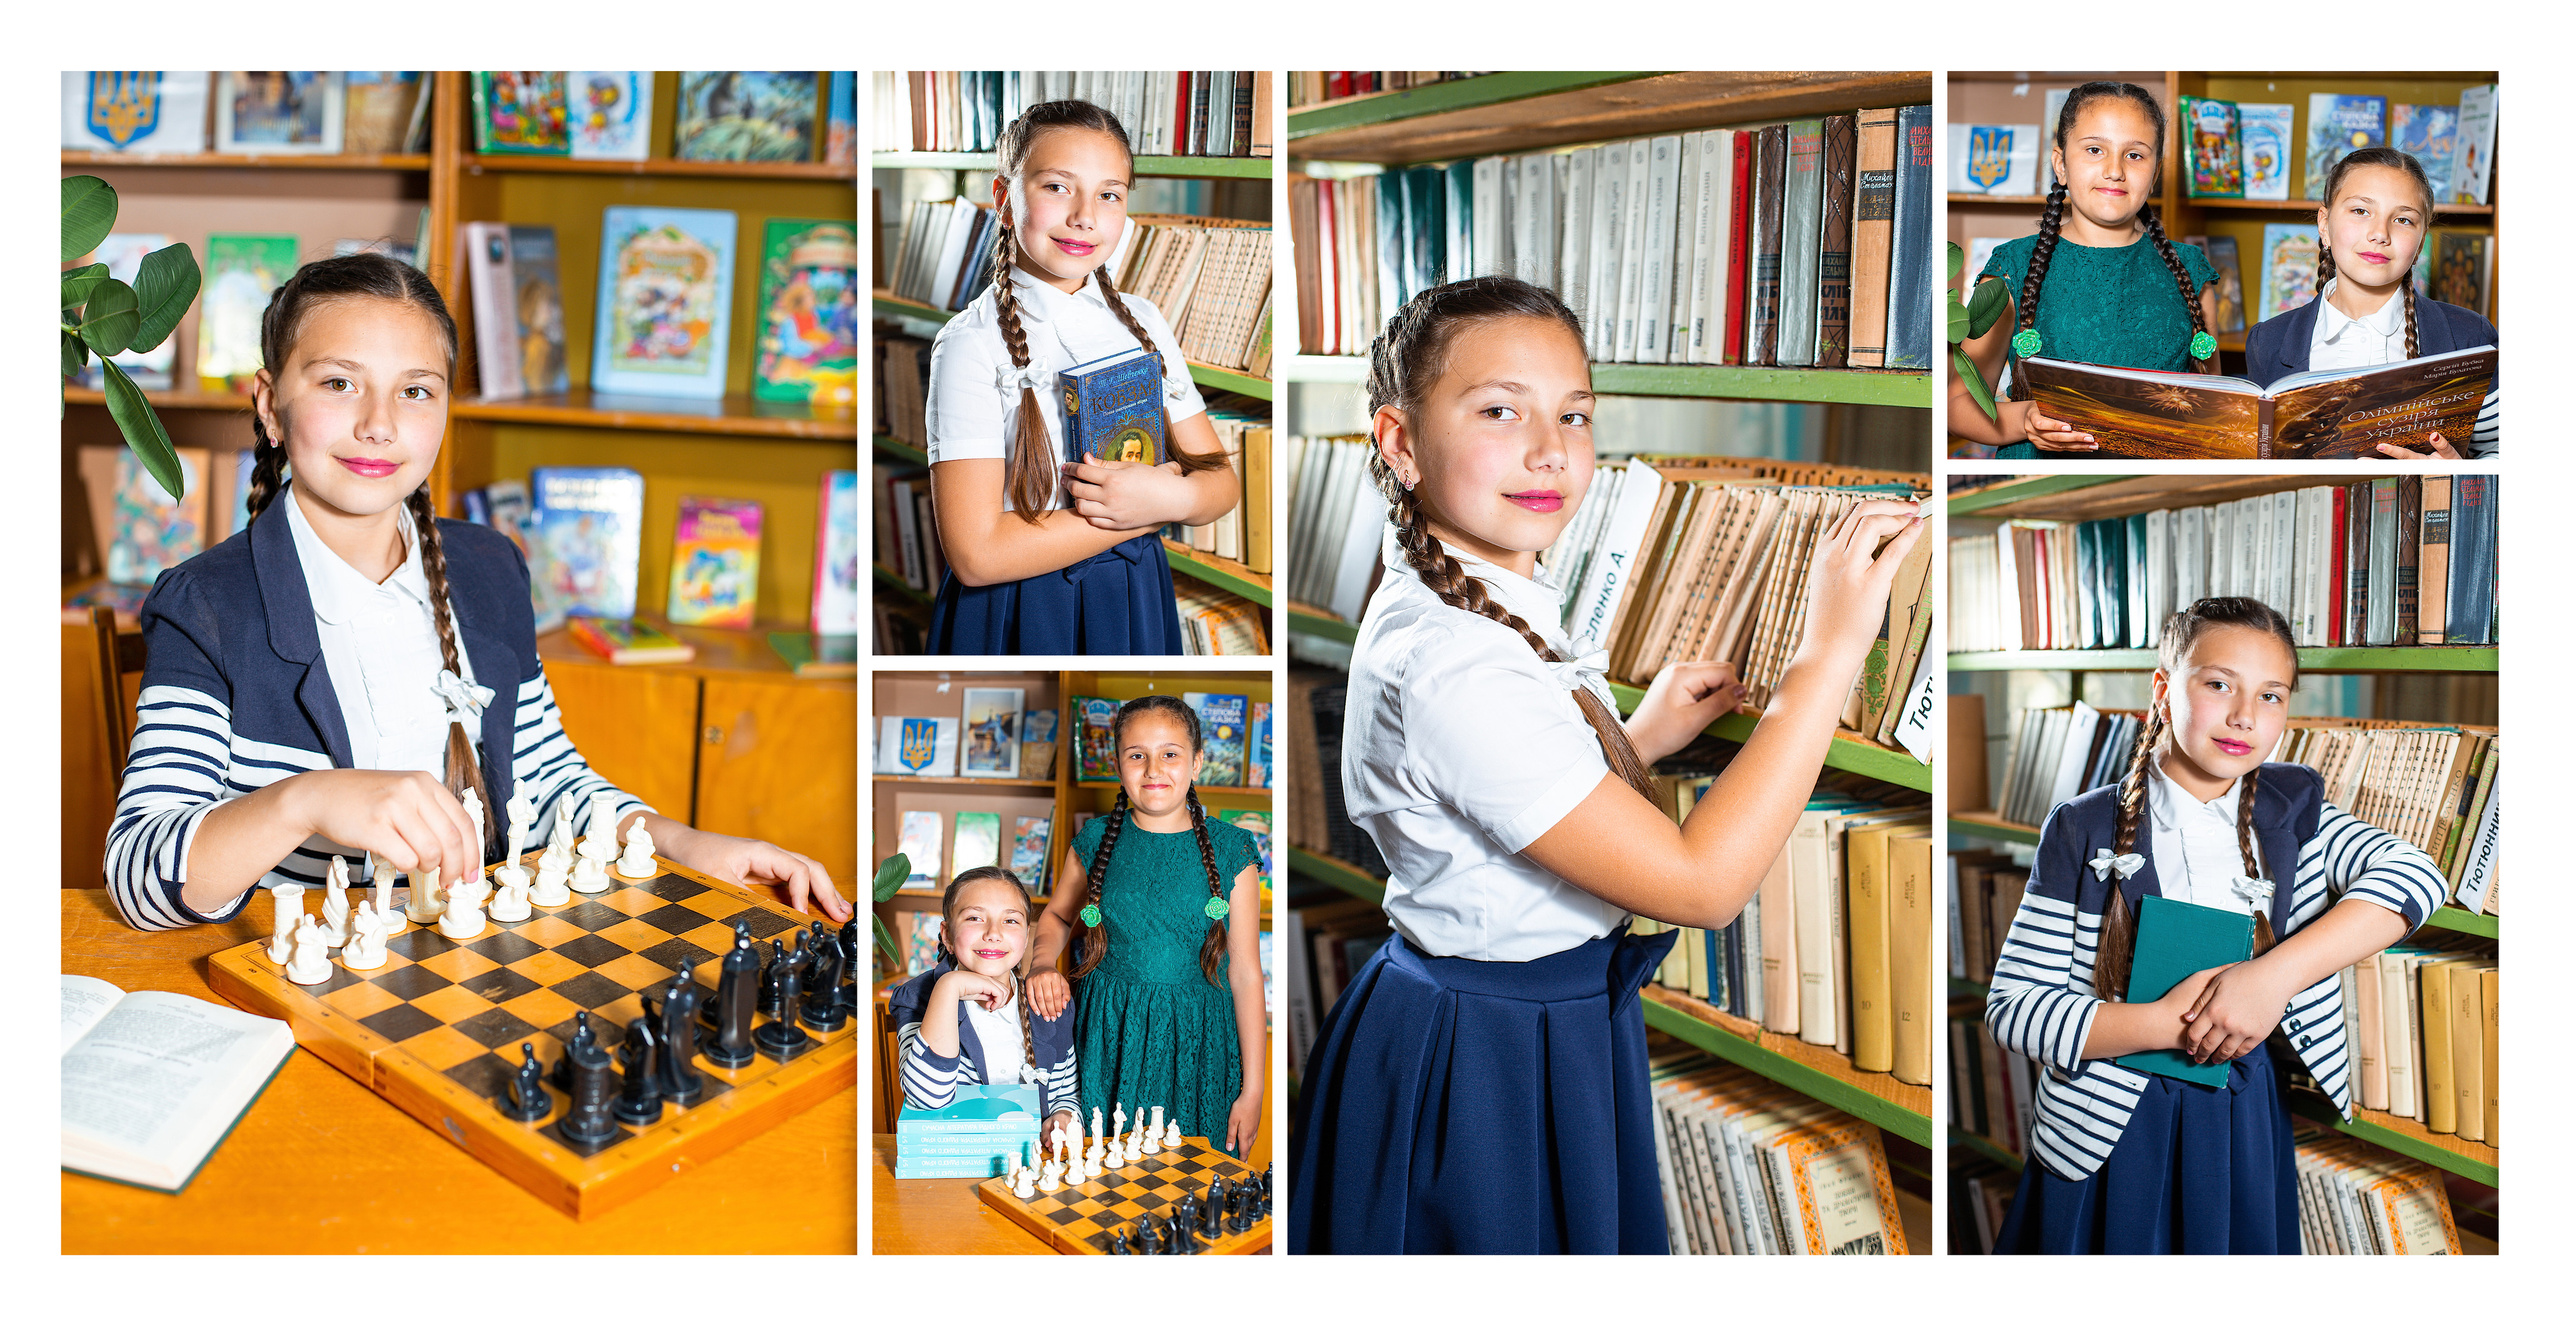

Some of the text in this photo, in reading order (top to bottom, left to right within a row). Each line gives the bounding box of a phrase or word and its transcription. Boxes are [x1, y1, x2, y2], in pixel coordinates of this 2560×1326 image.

[2423, 365, 2482, 380] Марія Булатова
[2433, 358, 2484, 372] Сергій Бубка
[1090, 379, 1157, 414] КОБЗАР
[2347, 391, 2475, 422] Олімпійське
[1607, 545, 1627, 569] А.
[1861, 1000, 1871, 1011] 10
[1902, 1012, 1911, 1022] 12
